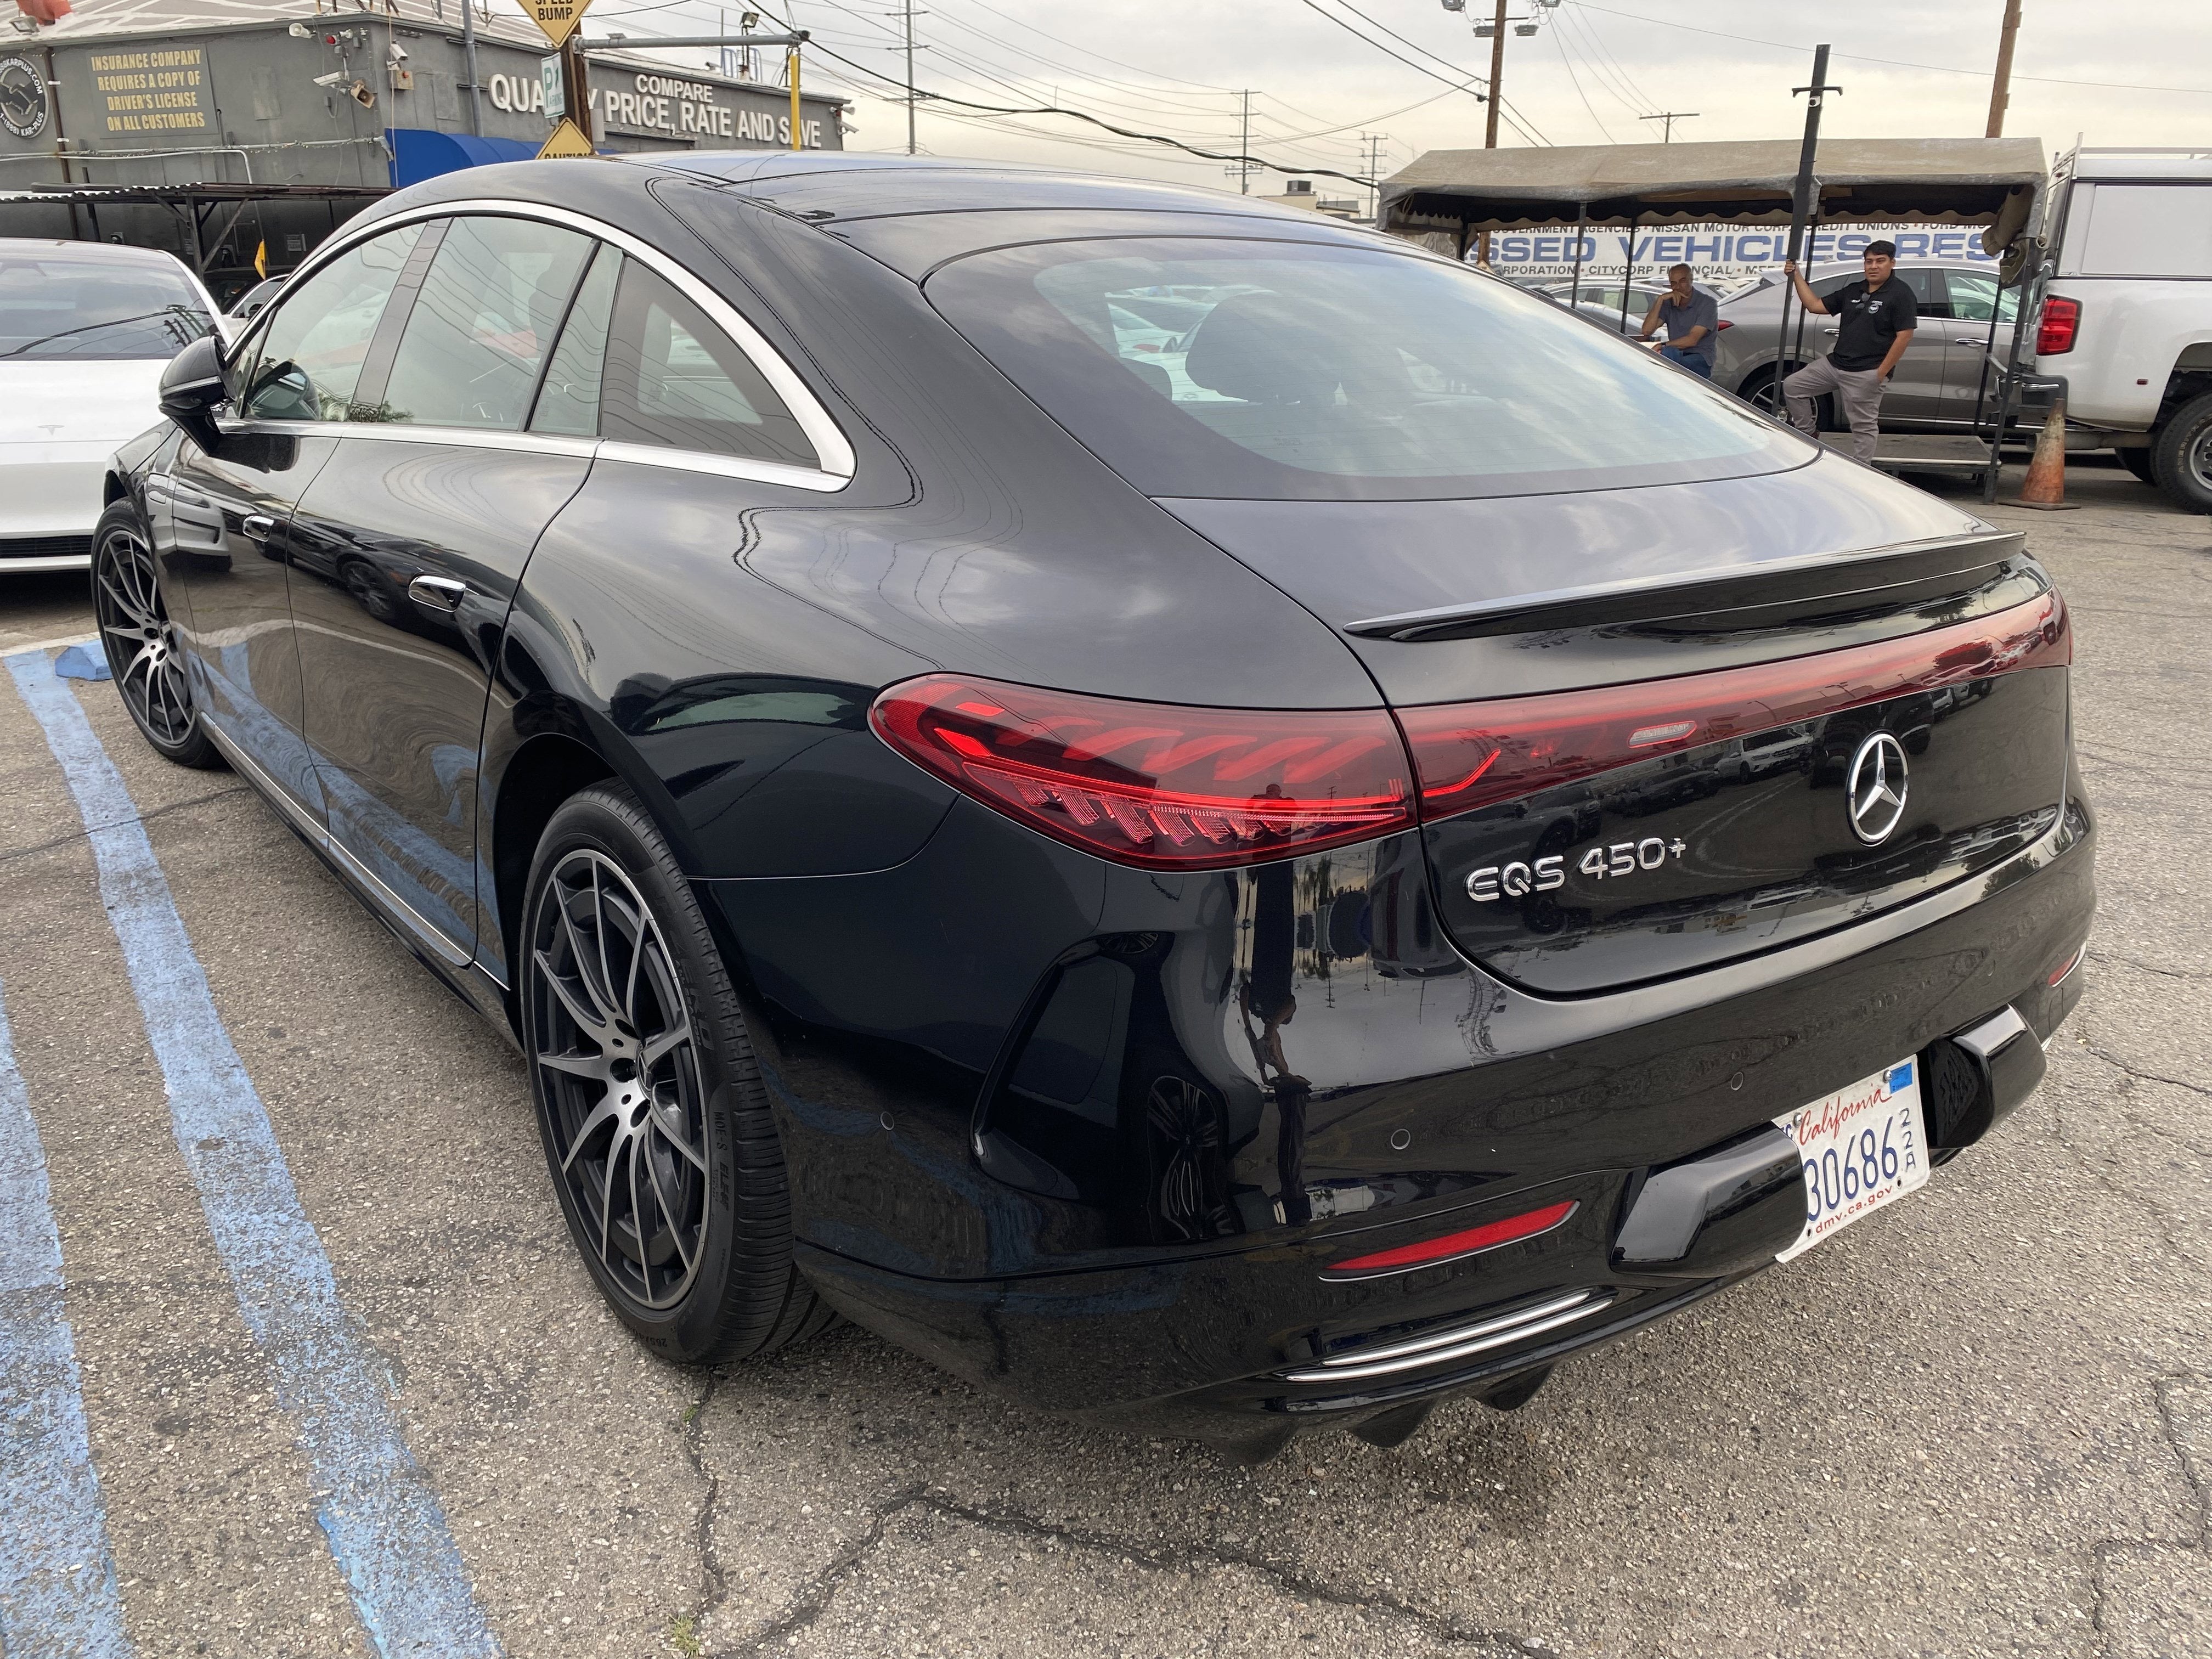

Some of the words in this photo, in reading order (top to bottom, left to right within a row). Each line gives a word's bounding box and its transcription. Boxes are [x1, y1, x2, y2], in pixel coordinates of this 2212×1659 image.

[538, 7, 572, 20] BUMP
[91, 53, 149, 71] INSURANCE
[150, 49, 200, 67] COMPANY
[97, 74, 145, 91] REQUIRES
[148, 74, 156, 88] A
[157, 71, 184, 88] COPY
[187, 70, 200, 86] OF
[635, 74, 713, 103] COMPARE
[106, 94, 153, 111] DRIVER'S
[154, 92, 198, 108] LICENSE
[489, 74, 598, 113] QUAY
[605, 90, 675, 136] PRICE,
[679, 101, 733, 137] RATE
[736, 110, 775, 142] AND
[777, 116, 822, 148] SVE
[106, 116, 122, 131] ON
[123, 115, 141, 130] ALL
[142, 112, 205, 129] CUSTOMERS
[1651, 224, 1700, 233] NISSAN
[1704, 223, 1750, 232] MOTOR
[1617, 235, 1872, 262] VEHICLES
[1589, 266, 1654, 275] CITYCORP
[1466, 854, 1565, 902] EQS
[1578, 837, 1687, 880] 450+
[1800, 1084, 1893, 1146] California
[1803, 1116, 1898, 1222] 30686
[1815, 1185, 1893, 1234] dmv.ca.gov
